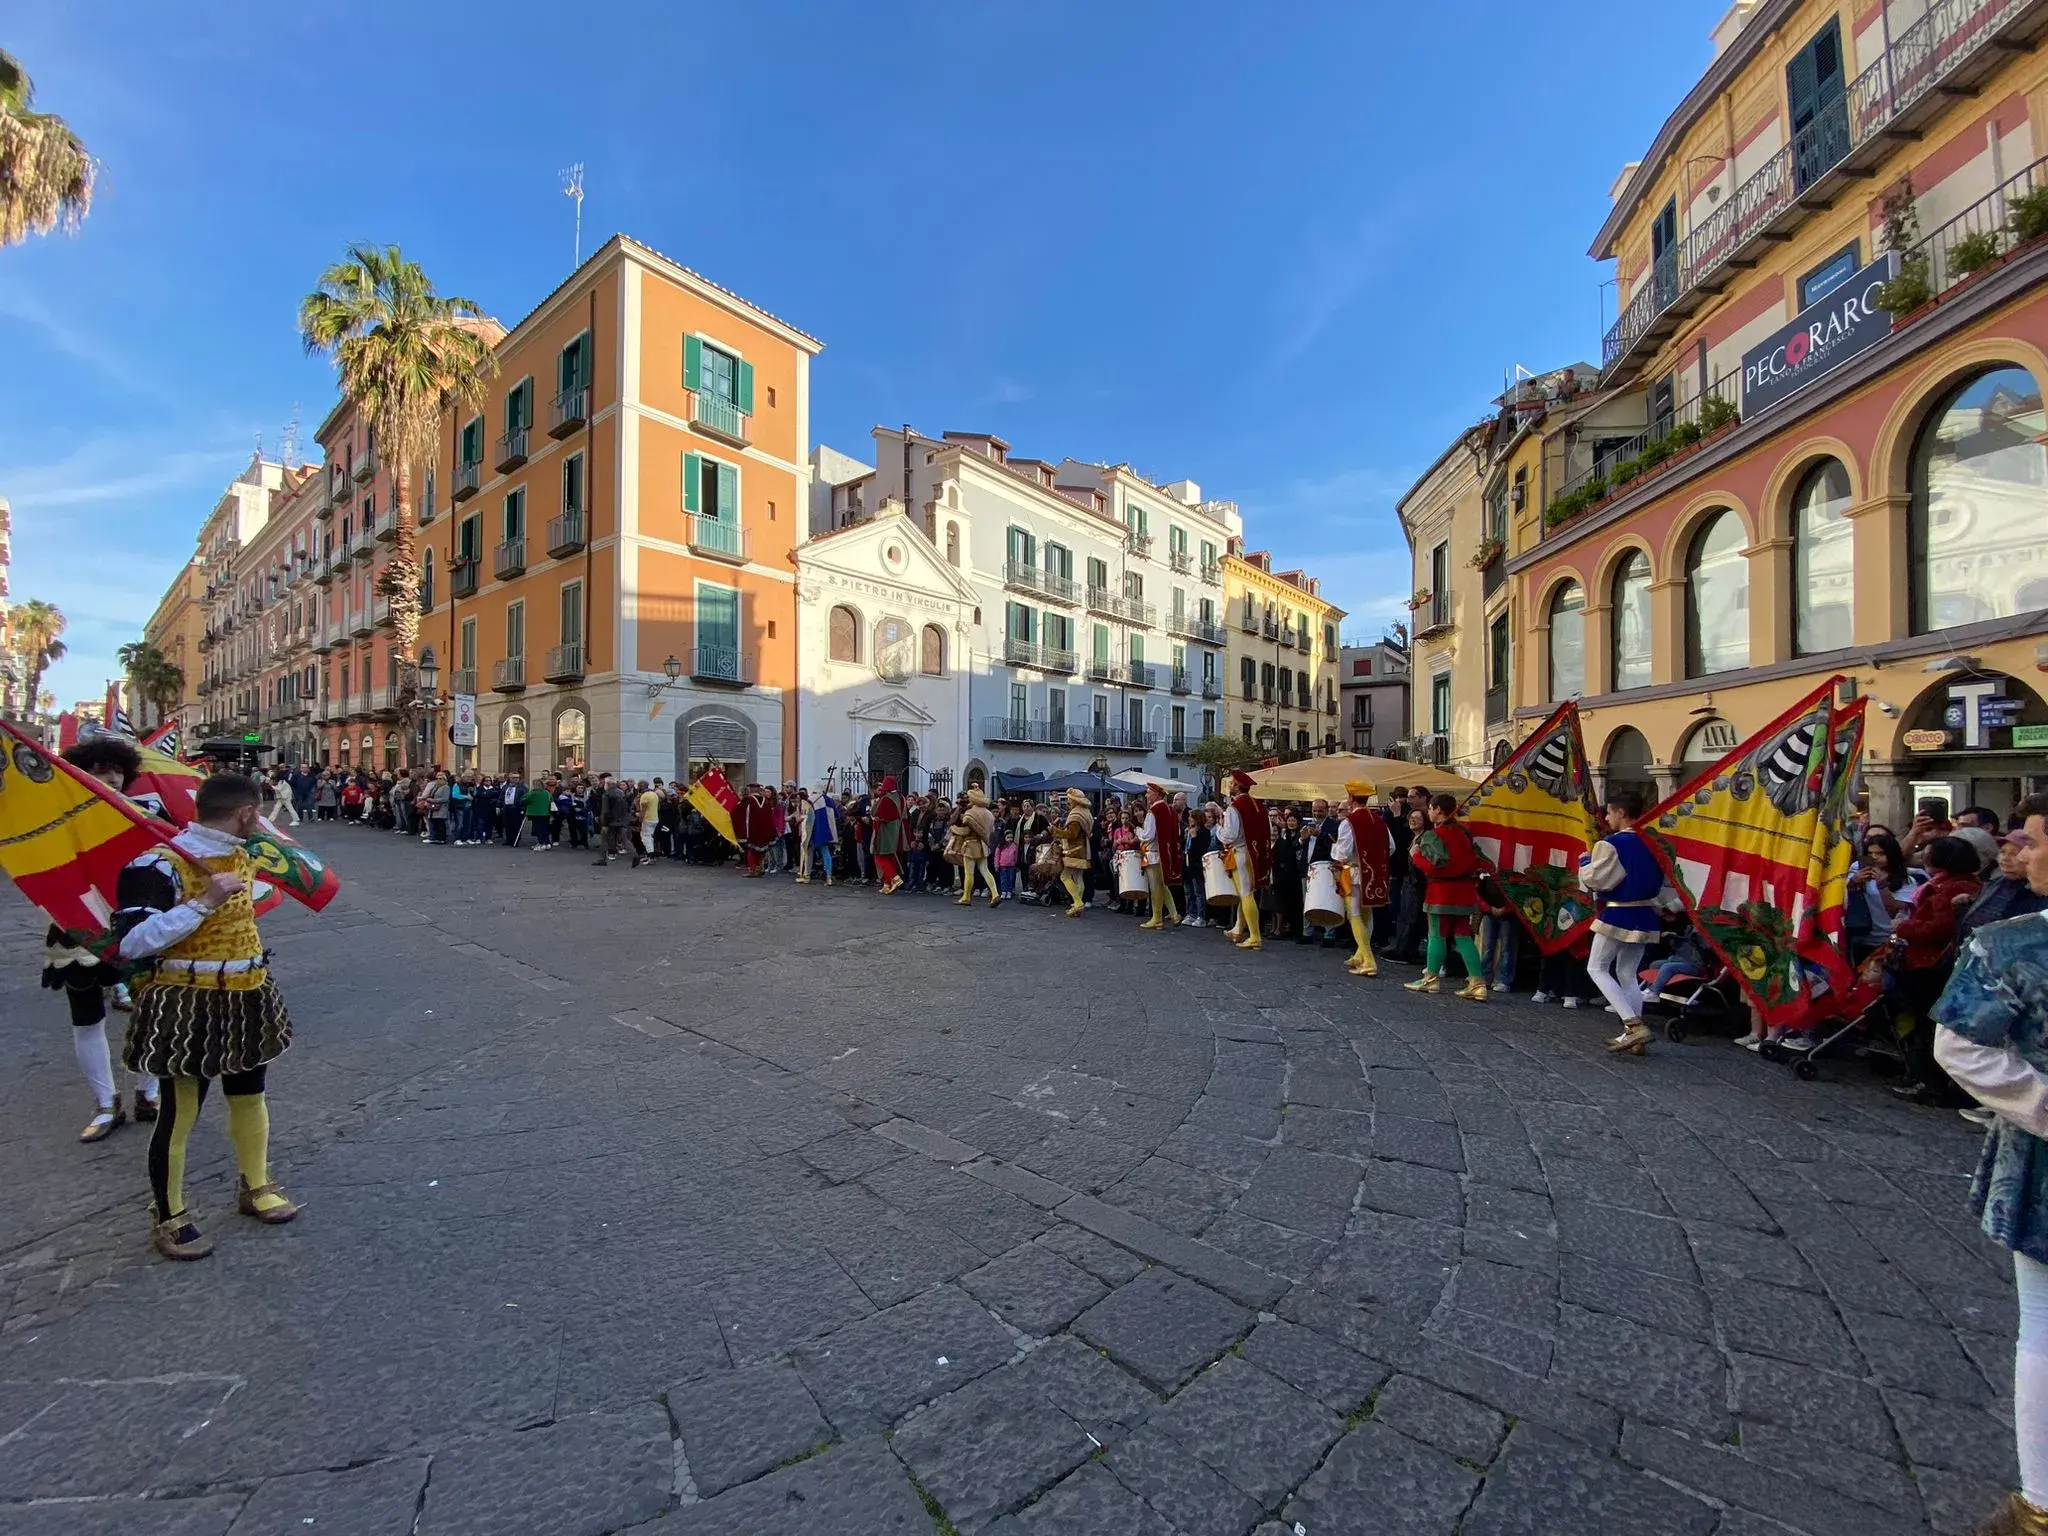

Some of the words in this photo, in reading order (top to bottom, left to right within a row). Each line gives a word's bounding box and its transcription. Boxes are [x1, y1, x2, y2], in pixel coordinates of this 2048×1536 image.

[1802, 327, 1855, 364] FRANCESCO
[841, 578, 888, 597] PIETRO
[891, 591, 903, 601] IN
[907, 595, 951, 612] VINCULIS
[1949, 682, 1996, 747] T
